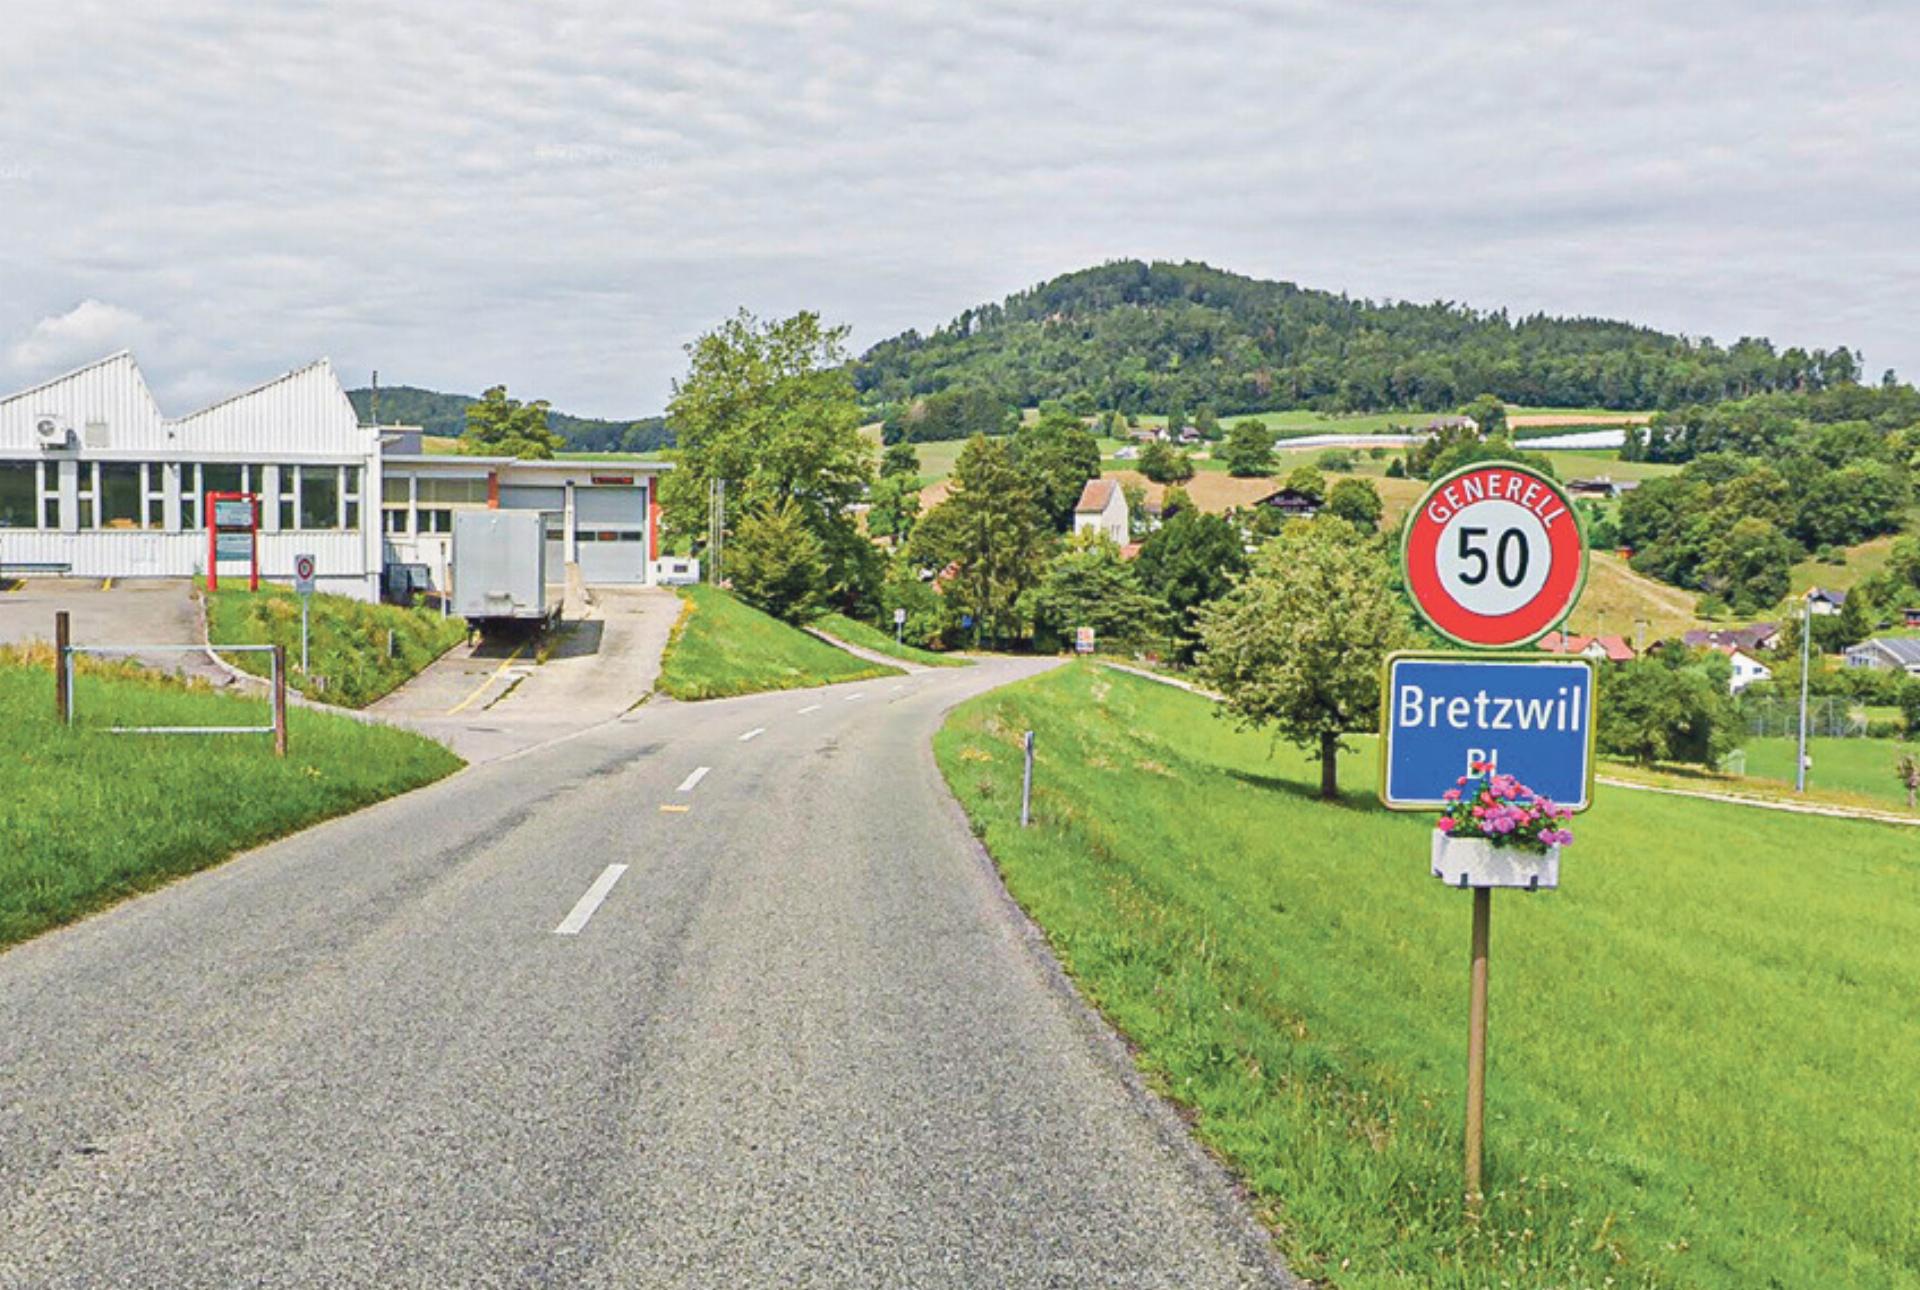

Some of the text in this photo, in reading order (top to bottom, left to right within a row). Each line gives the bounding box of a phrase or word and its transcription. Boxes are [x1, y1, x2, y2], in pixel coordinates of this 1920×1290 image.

[1428, 474, 1566, 528] GENERELL
[1458, 527, 1529, 588] 50
[1399, 685, 1581, 731] Bretzwil
